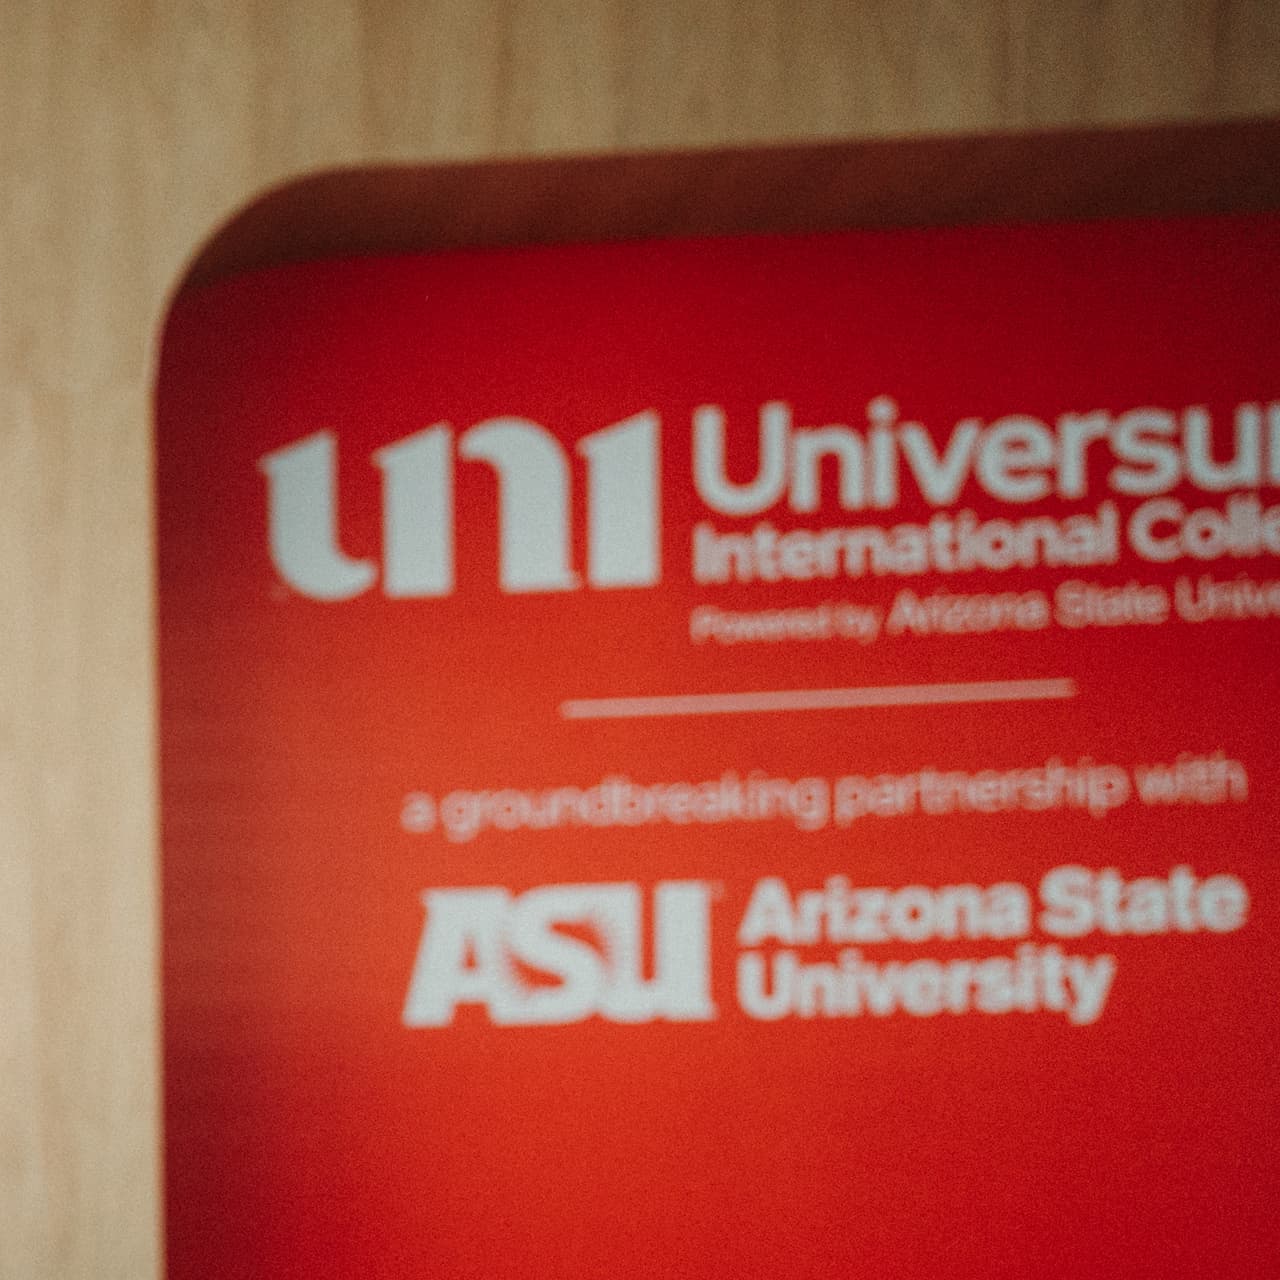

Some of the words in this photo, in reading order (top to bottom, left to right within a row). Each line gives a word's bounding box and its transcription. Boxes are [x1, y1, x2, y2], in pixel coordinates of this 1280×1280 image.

[693, 398, 1280, 516] Universu
[693, 501, 1119, 584] International
[692, 603, 831, 643] Powered
[838, 602, 880, 644] by
[888, 588, 1049, 635] Arizona
[1055, 580, 1169, 628] State
[402, 792, 436, 834] a
[442, 771, 829, 842] groundbreaking
[835, 757, 1130, 829] partnership
[1137, 750, 1248, 805] with
[740, 876, 1031, 945] Arizona
[1040, 866, 1248, 938] State
[402, 880, 718, 1027] ASU
[739, 944, 1115, 1025] University
